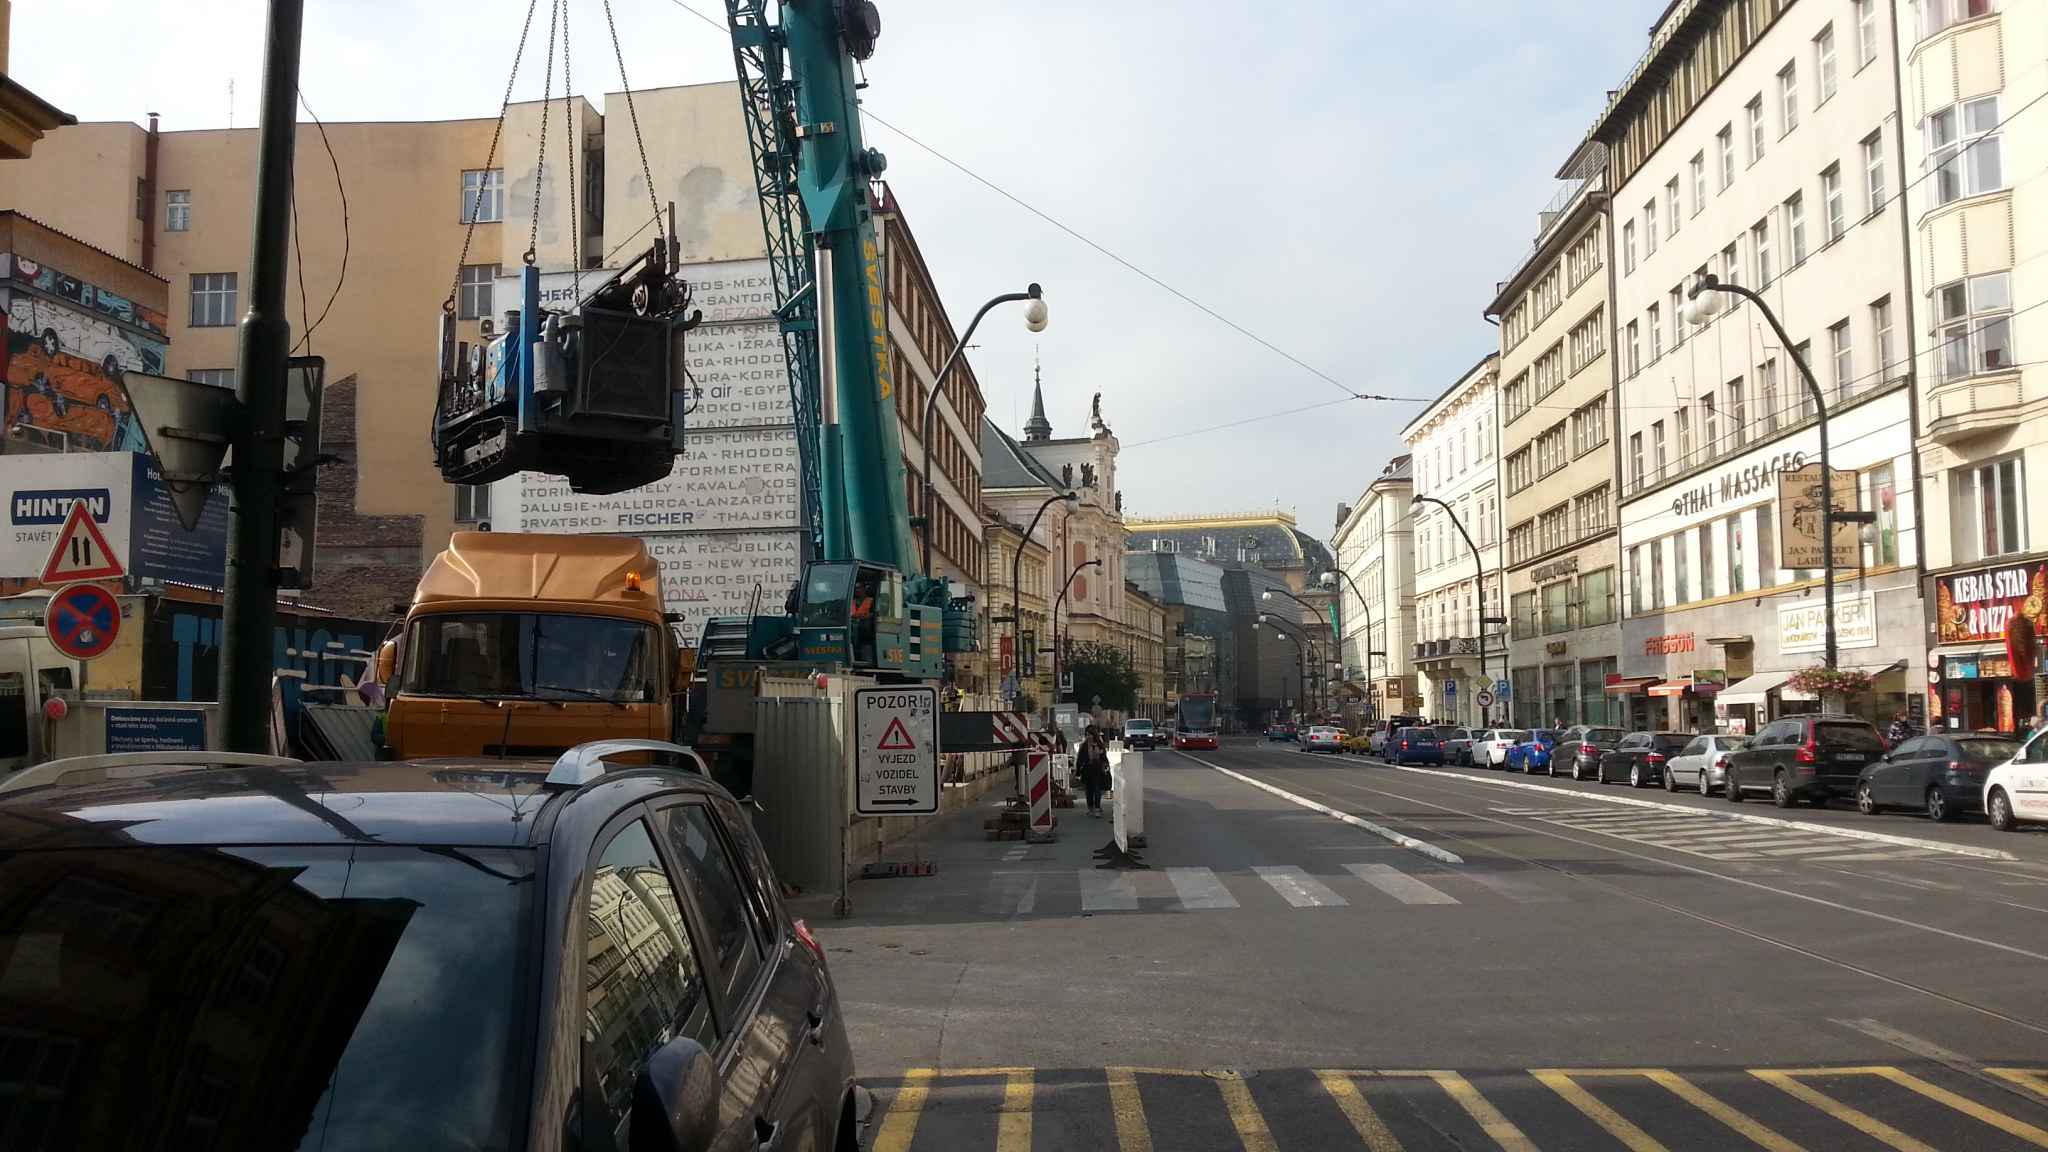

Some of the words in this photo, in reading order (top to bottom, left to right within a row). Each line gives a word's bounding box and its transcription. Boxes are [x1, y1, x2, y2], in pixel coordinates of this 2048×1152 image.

[710, 382, 732, 399] air
[721, 447, 796, 460] RHODOS
[16, 497, 104, 517] HINTN
[1682, 482, 1713, 517] THAI
[617, 511, 694, 527] FISCHER
[708, 559, 744, 570] NEW
[750, 557, 796, 568] YORK
[1953, 572, 1995, 605] KEBAB
[1994, 568, 2029, 599] STAR
[1968, 607, 1979, 636] &
[866, 694, 923, 710] POZOR!
[876, 769, 919, 780] VOZIDEL
[879, 784, 917, 796] STAVBY
